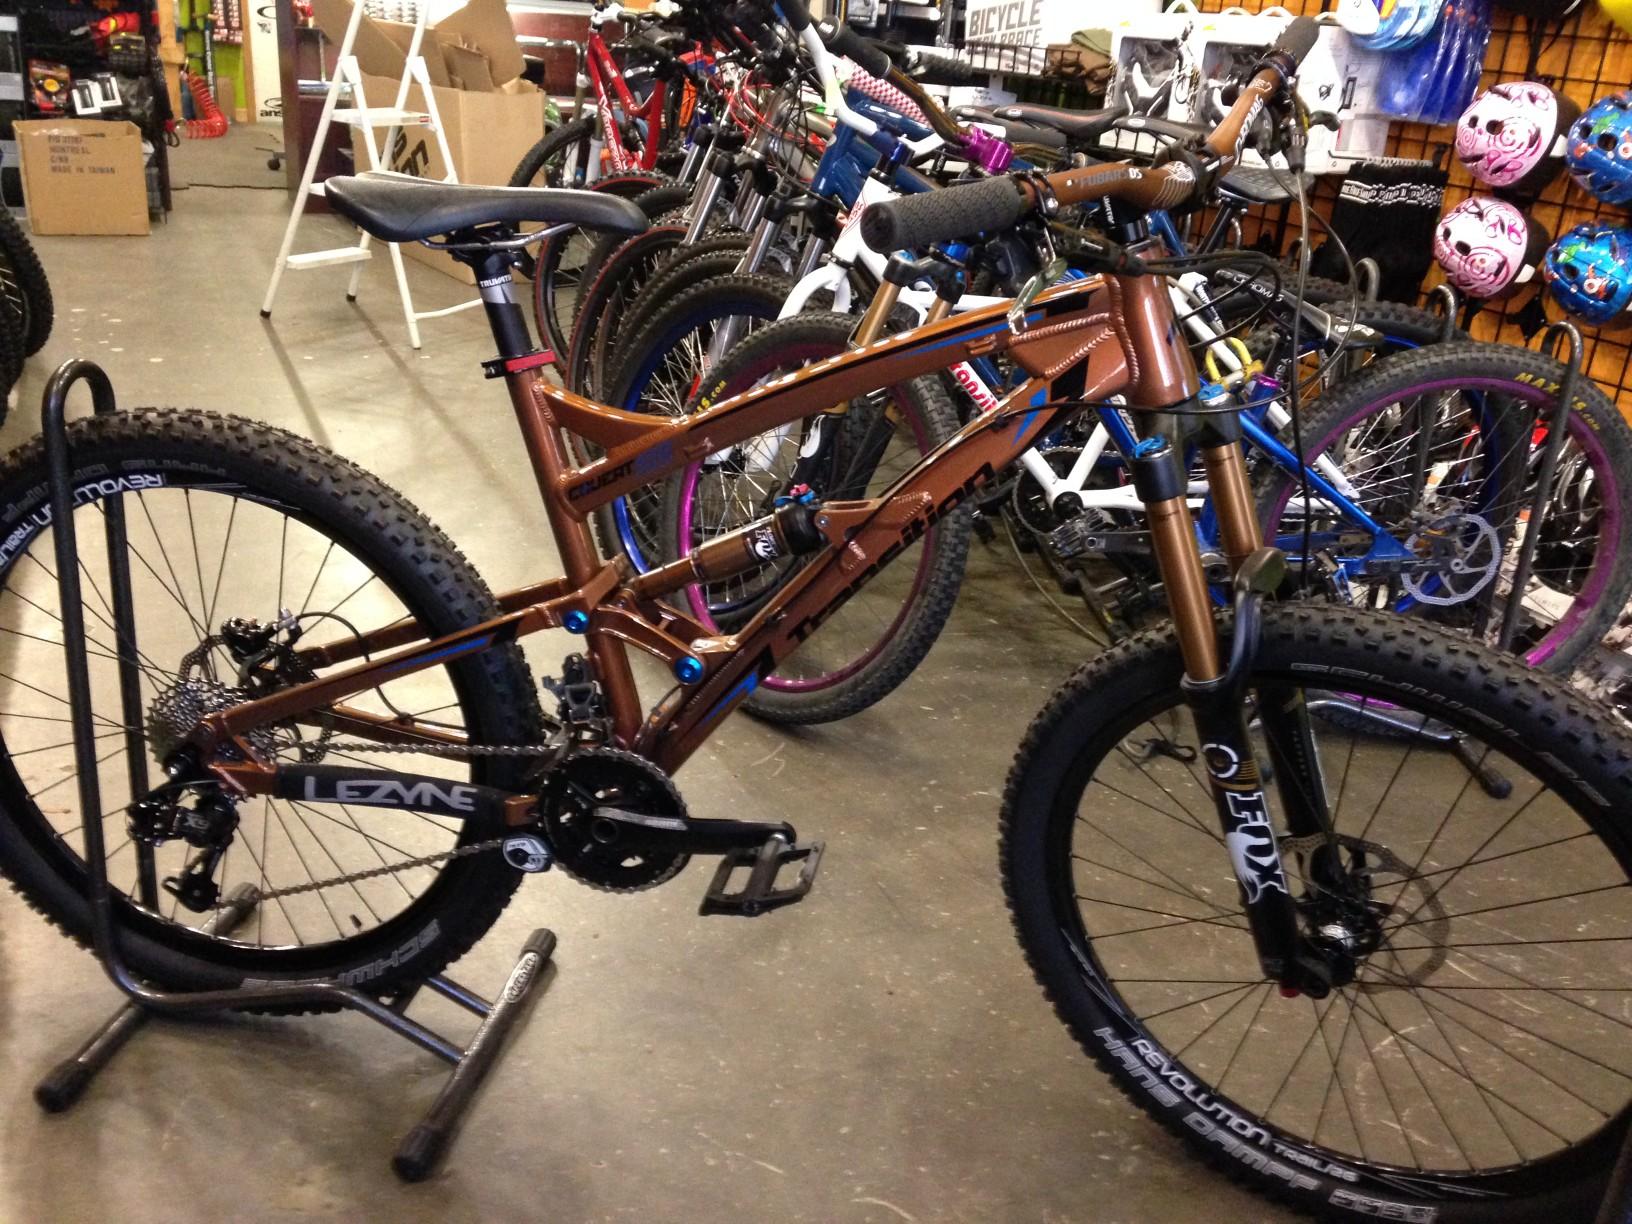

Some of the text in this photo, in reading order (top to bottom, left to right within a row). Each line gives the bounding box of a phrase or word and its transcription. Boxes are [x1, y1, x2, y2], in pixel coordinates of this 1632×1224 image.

[969, 0, 1041, 37] BICYCLE
[51, 165, 72, 174] MADE
[88, 166, 116, 174] TAIWAN
[304, 775, 478, 812] LEZYNE
[1225, 791, 1289, 904] FOX
[1093, 1026, 1323, 1191] HANS DAMPF
[1132, 1039, 1273, 1146] REVOLUTION
